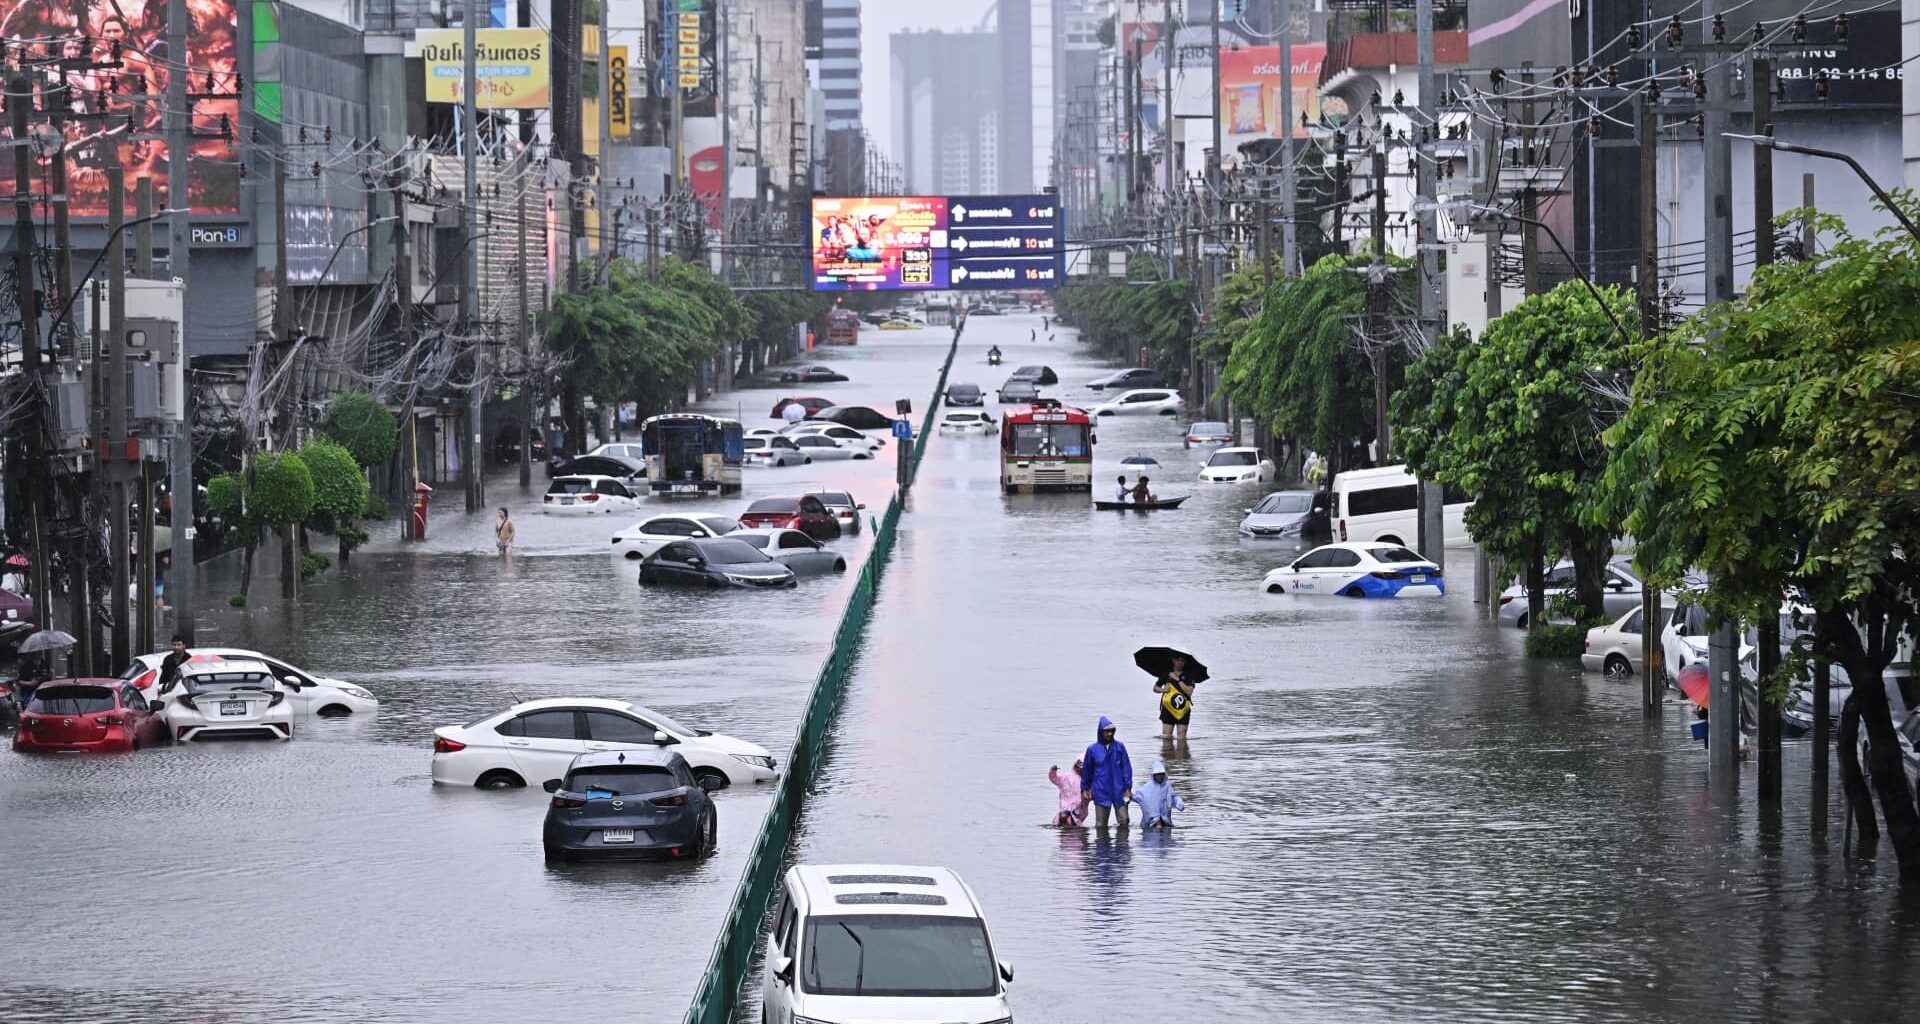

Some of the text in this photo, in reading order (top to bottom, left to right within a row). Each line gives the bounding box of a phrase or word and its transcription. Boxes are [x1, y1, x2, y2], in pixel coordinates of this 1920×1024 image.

[1029, 207, 1037, 217] 6
[1025, 238, 1037, 248] 10
[1026, 269, 1037, 279] 16
